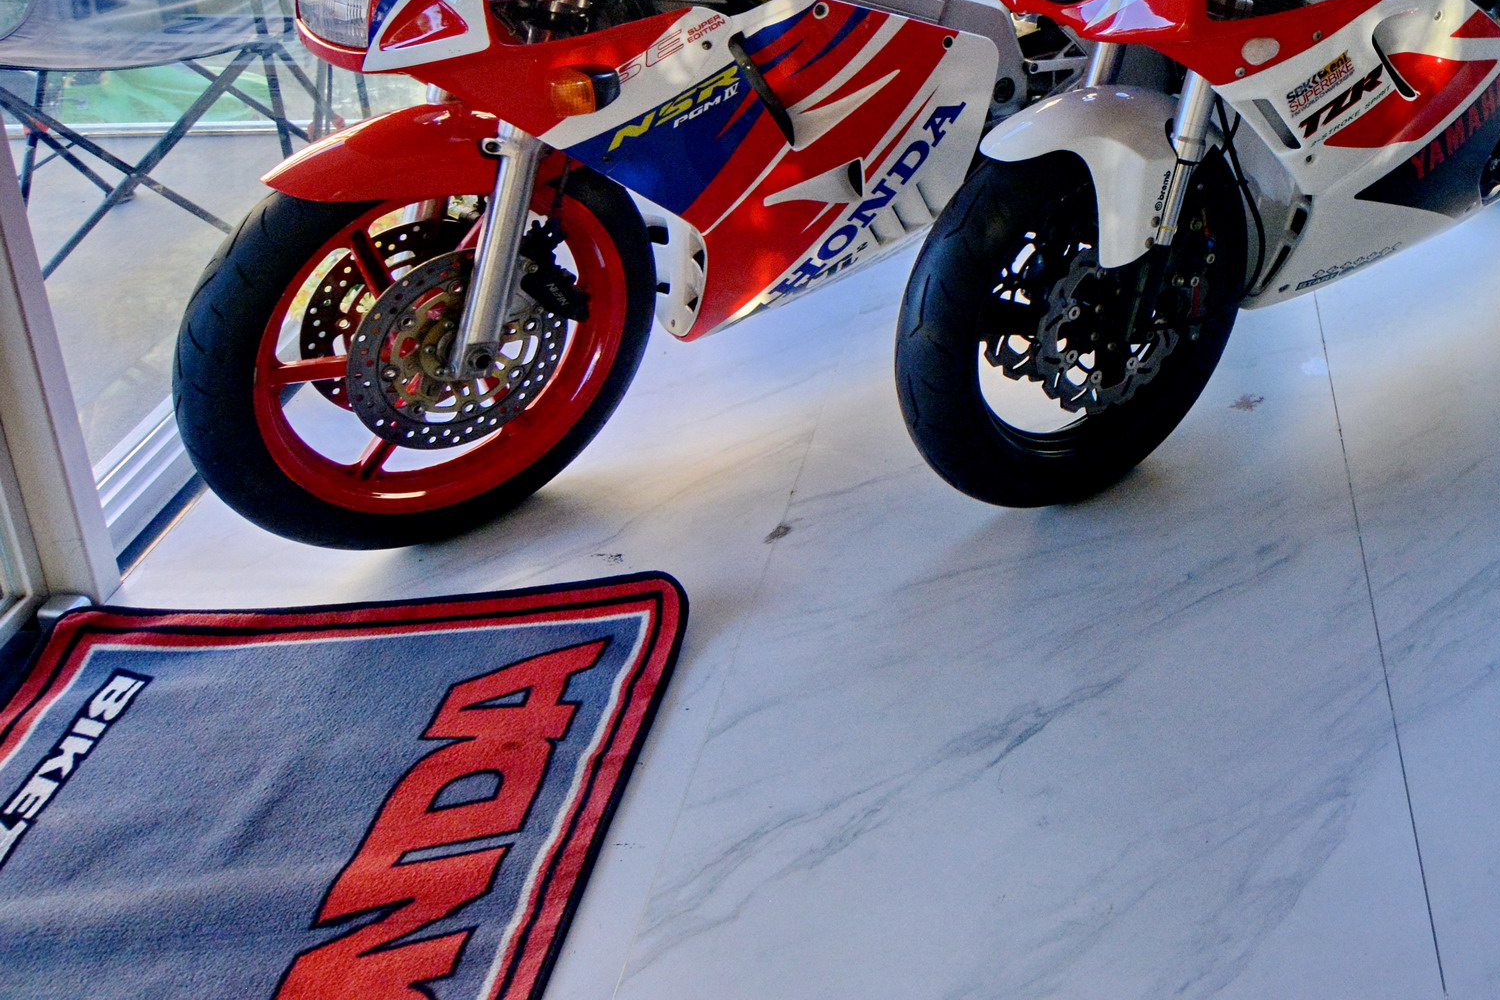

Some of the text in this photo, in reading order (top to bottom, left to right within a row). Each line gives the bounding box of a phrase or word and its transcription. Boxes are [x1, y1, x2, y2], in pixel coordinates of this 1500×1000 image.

[686, 14, 722, 36] SUPER
[686, 18, 726, 44] EDITION
[607, 65, 741, 153] NSR
[673, 82, 740, 129] PGM IV
[1289, 61, 1355, 113] SUPERBIKE
[1298, 63, 1384, 139] TZR
[768, 102, 967, 297] HONDA
